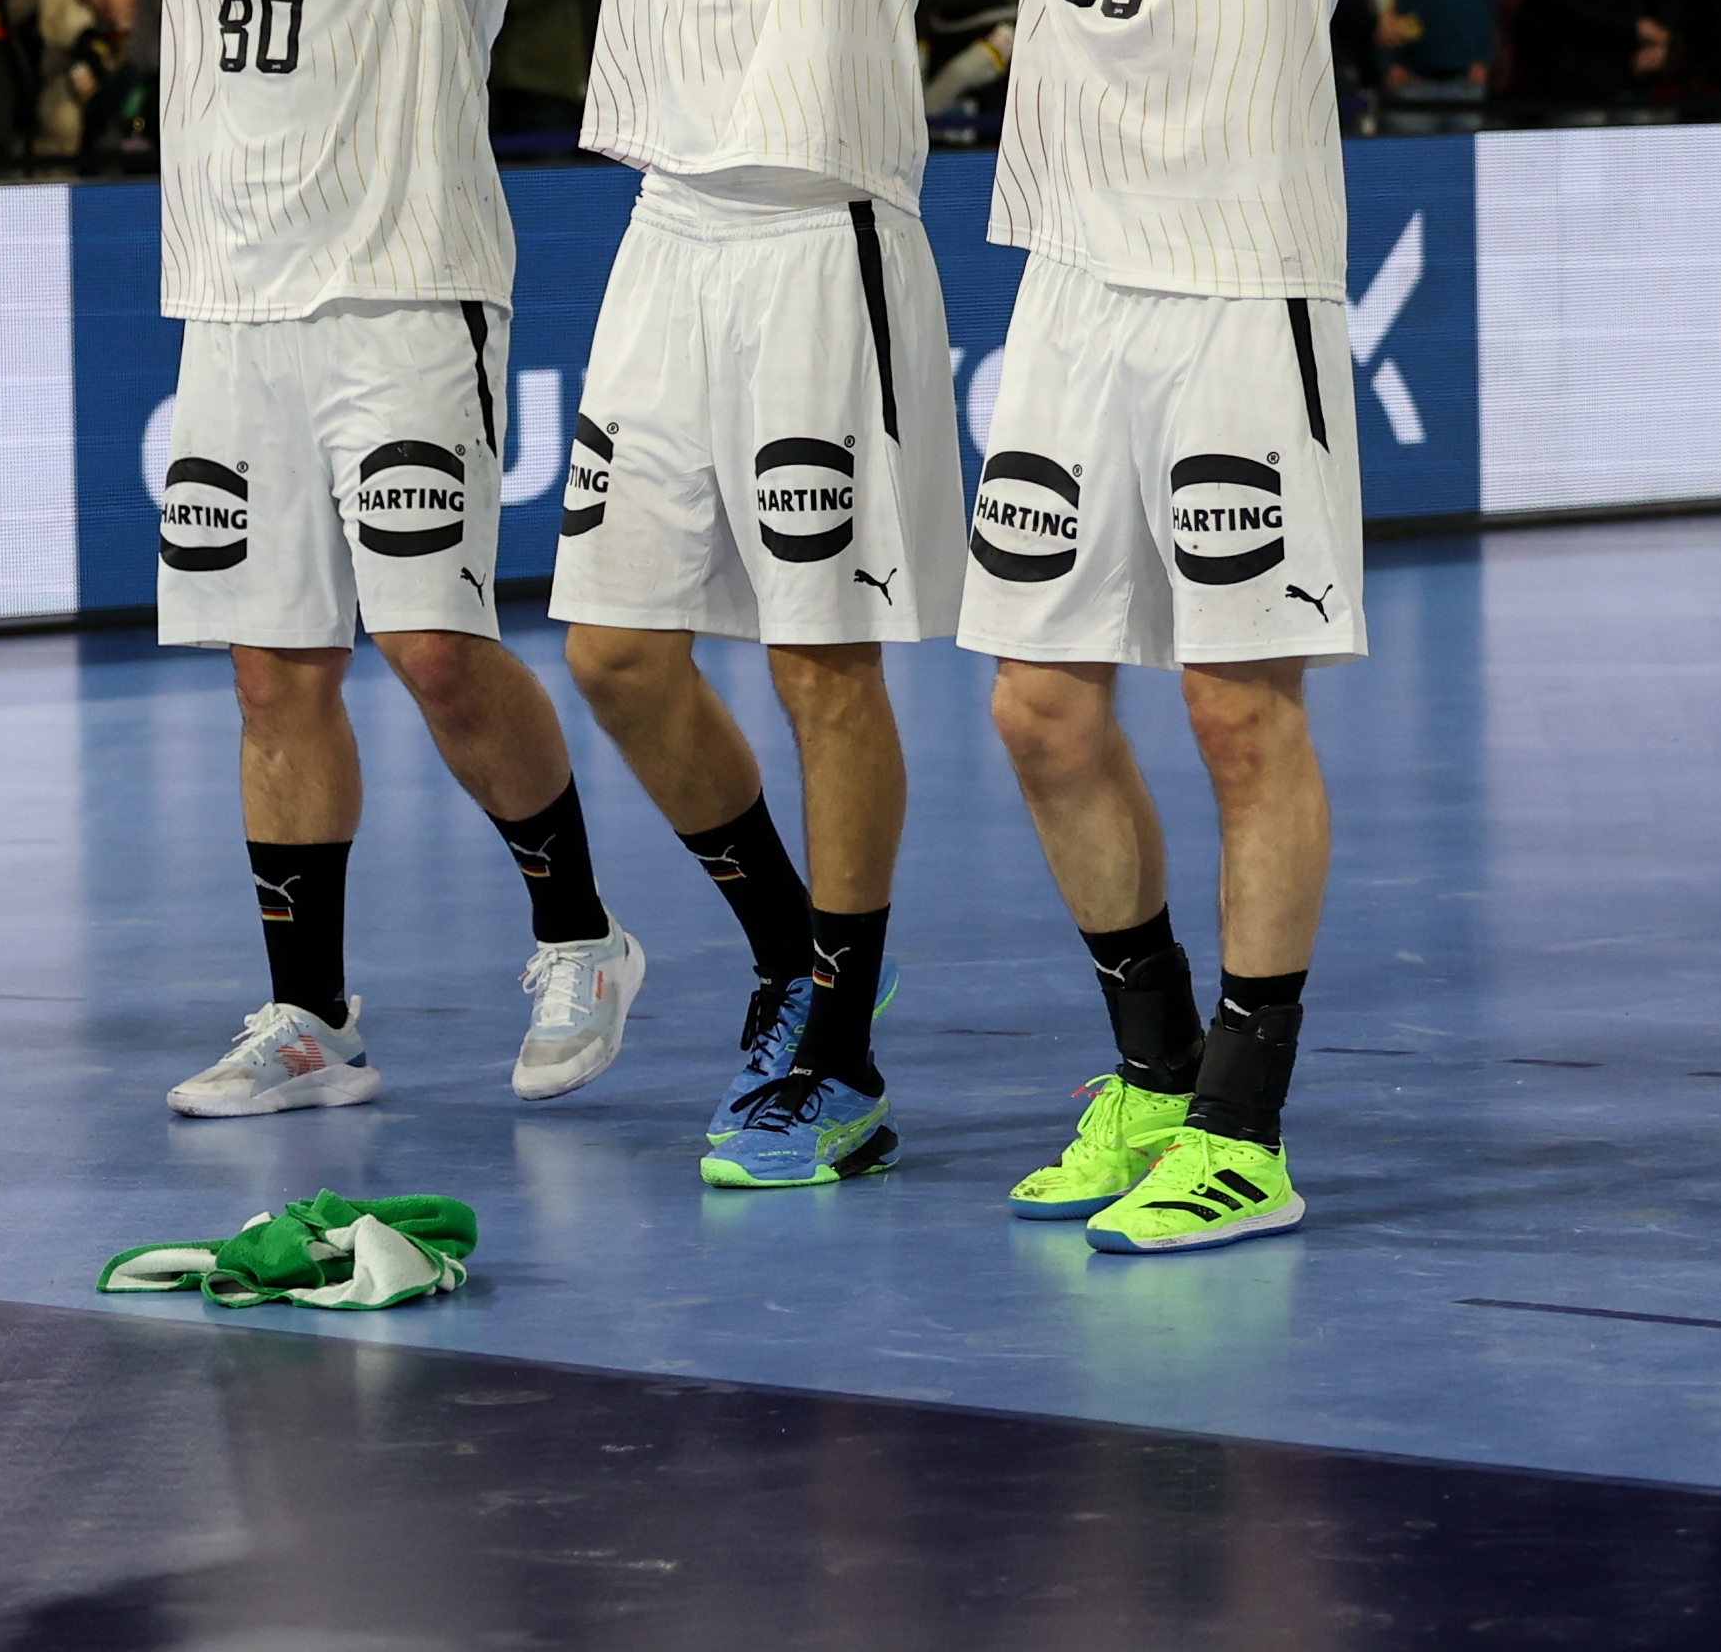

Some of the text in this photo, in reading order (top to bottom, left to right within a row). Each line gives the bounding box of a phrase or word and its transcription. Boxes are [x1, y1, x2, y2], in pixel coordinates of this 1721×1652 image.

[568, 464, 609, 492] TING
[358, 487, 465, 513] HARTING
[757, 486, 853, 512] HARTING
[161, 501, 248, 530] HARTING
[976, 493, 1078, 540] HARTING
[1172, 505, 1283, 532] HARTING
